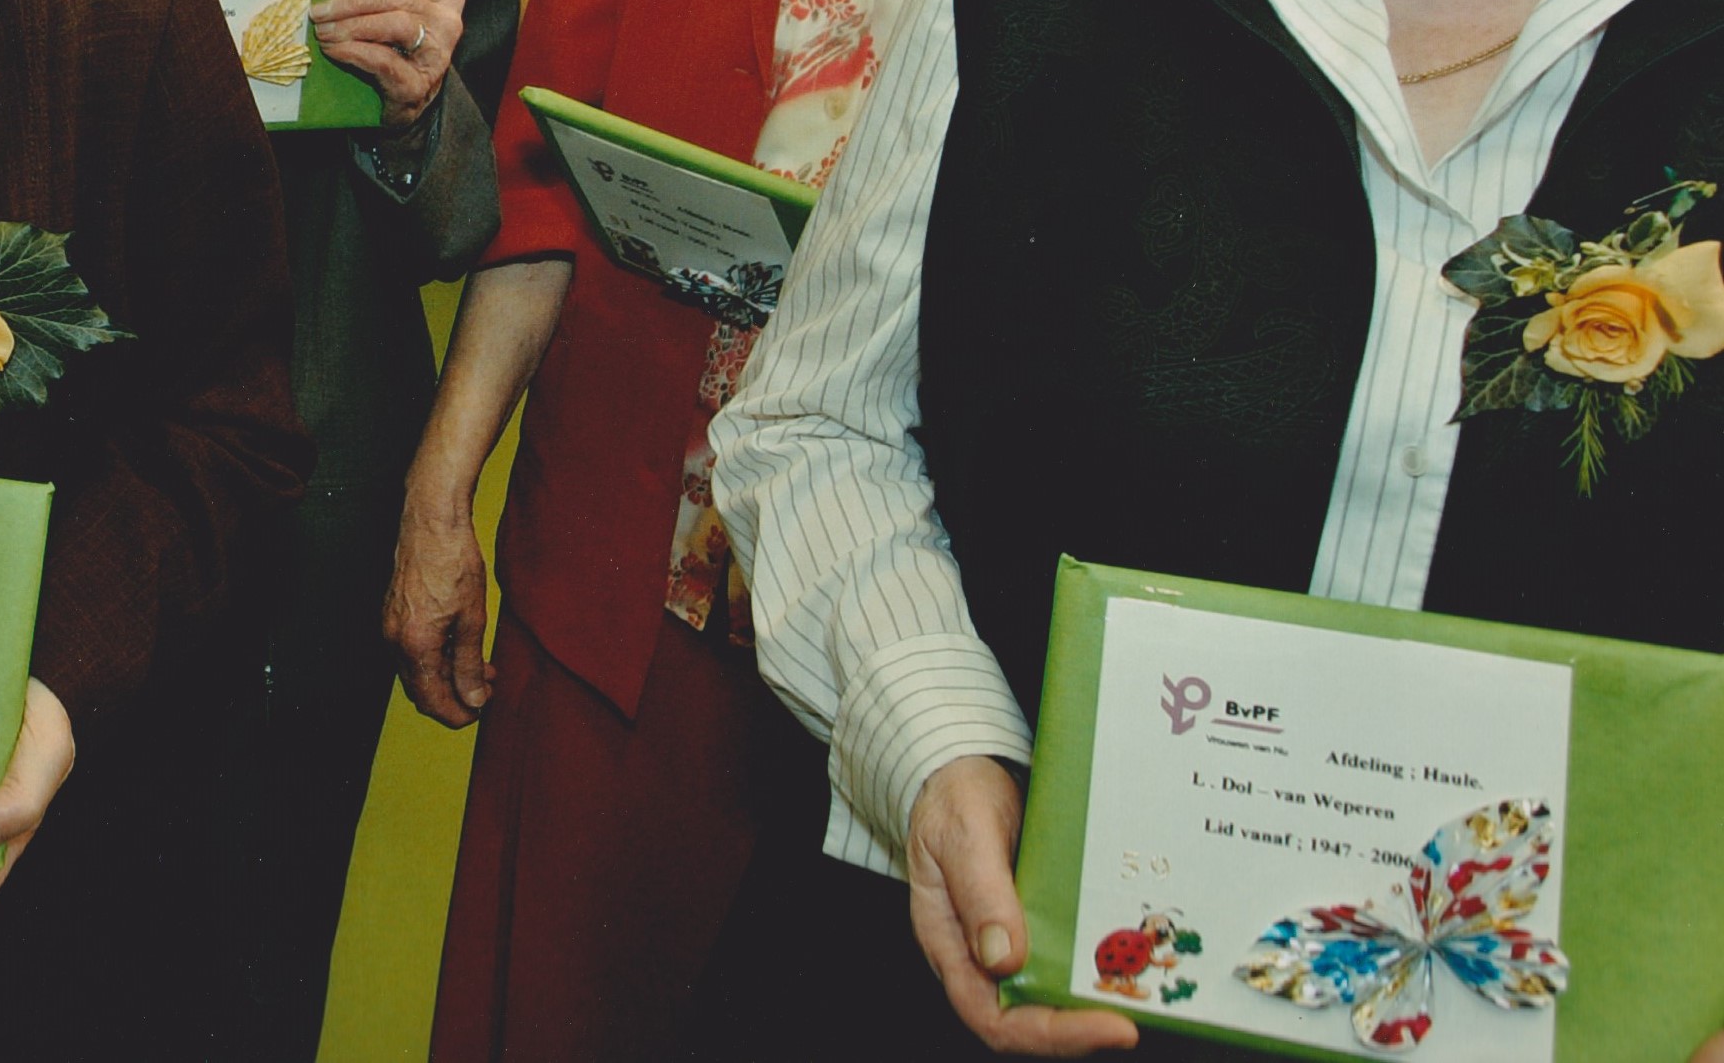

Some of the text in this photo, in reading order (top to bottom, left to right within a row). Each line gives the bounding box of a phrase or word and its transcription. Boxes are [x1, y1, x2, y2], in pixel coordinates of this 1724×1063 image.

[1225, 701, 1281, 722] BvPF
[1206, 735, 1251, 752] Vrouwen
[1325, 751, 1405, 780] Afdeling
[1423, 766, 1484, 792] Haule.
[1192, 771, 1206, 787] L
[1221, 776, 1254, 796] Dol
[1273, 789, 1307, 806] van
[1313, 793, 1396, 821] Weperen
[1204, 817, 1235, 837] Lid
[1239, 826, 1293, 848] vanaf
[1310, 838, 1353, 857] 1947
[1370, 848, 1414, 868] 2006
